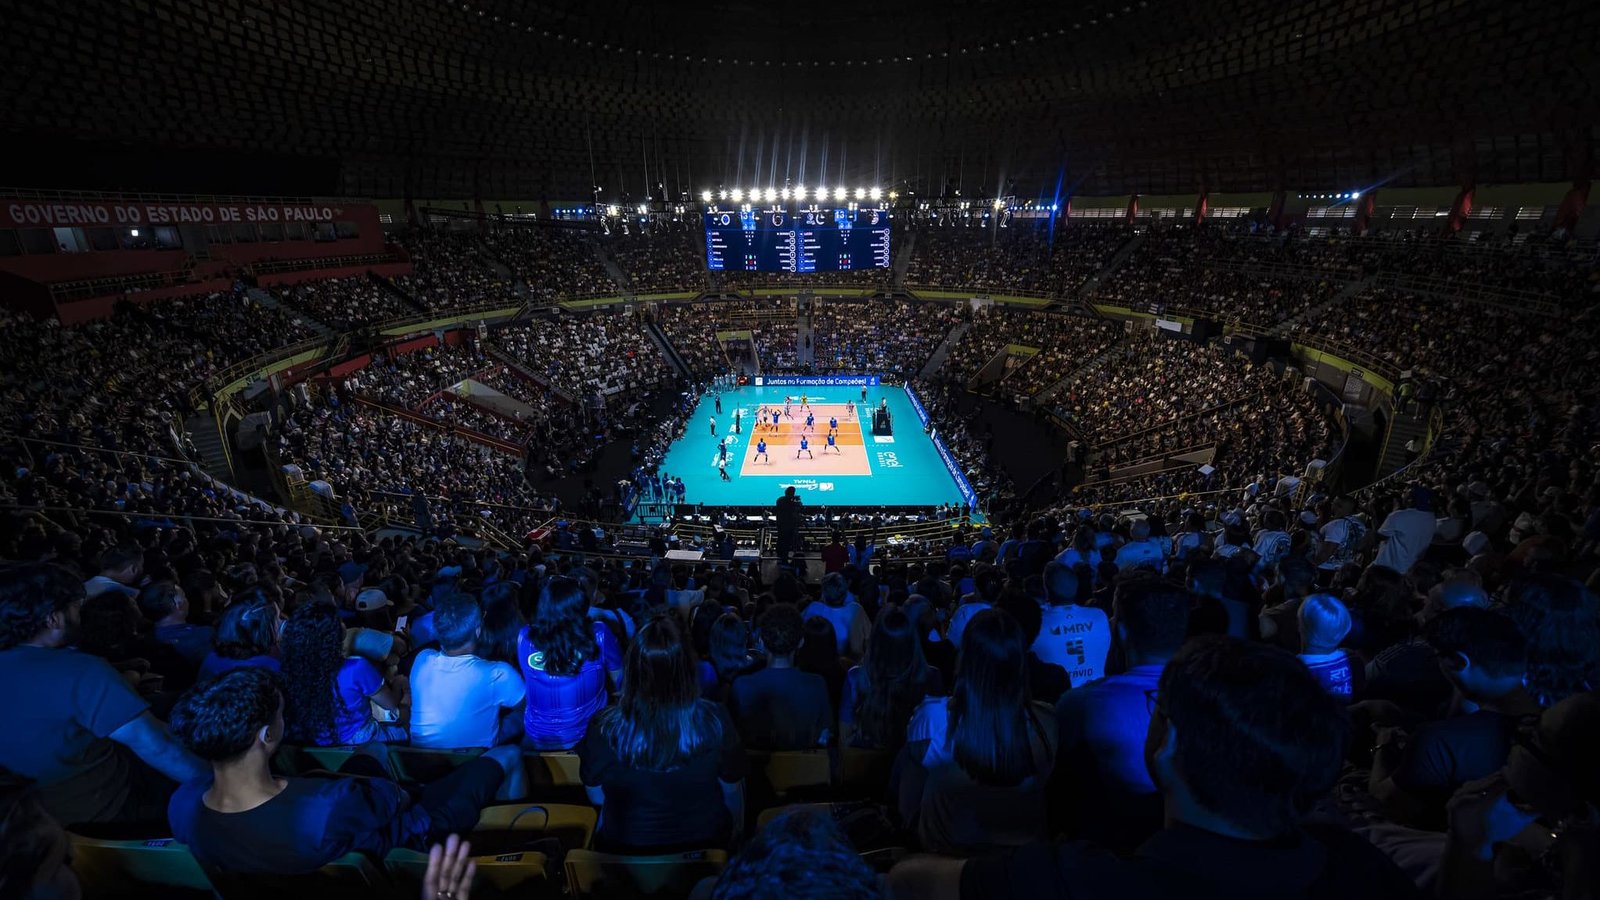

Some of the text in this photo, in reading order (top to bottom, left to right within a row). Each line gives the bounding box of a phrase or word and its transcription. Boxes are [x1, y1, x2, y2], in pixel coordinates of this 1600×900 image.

[9, 204, 333, 224] GOVERNO DO ESTADO DE SÃO PAULO
[1063, 621, 1093, 634] MRV
